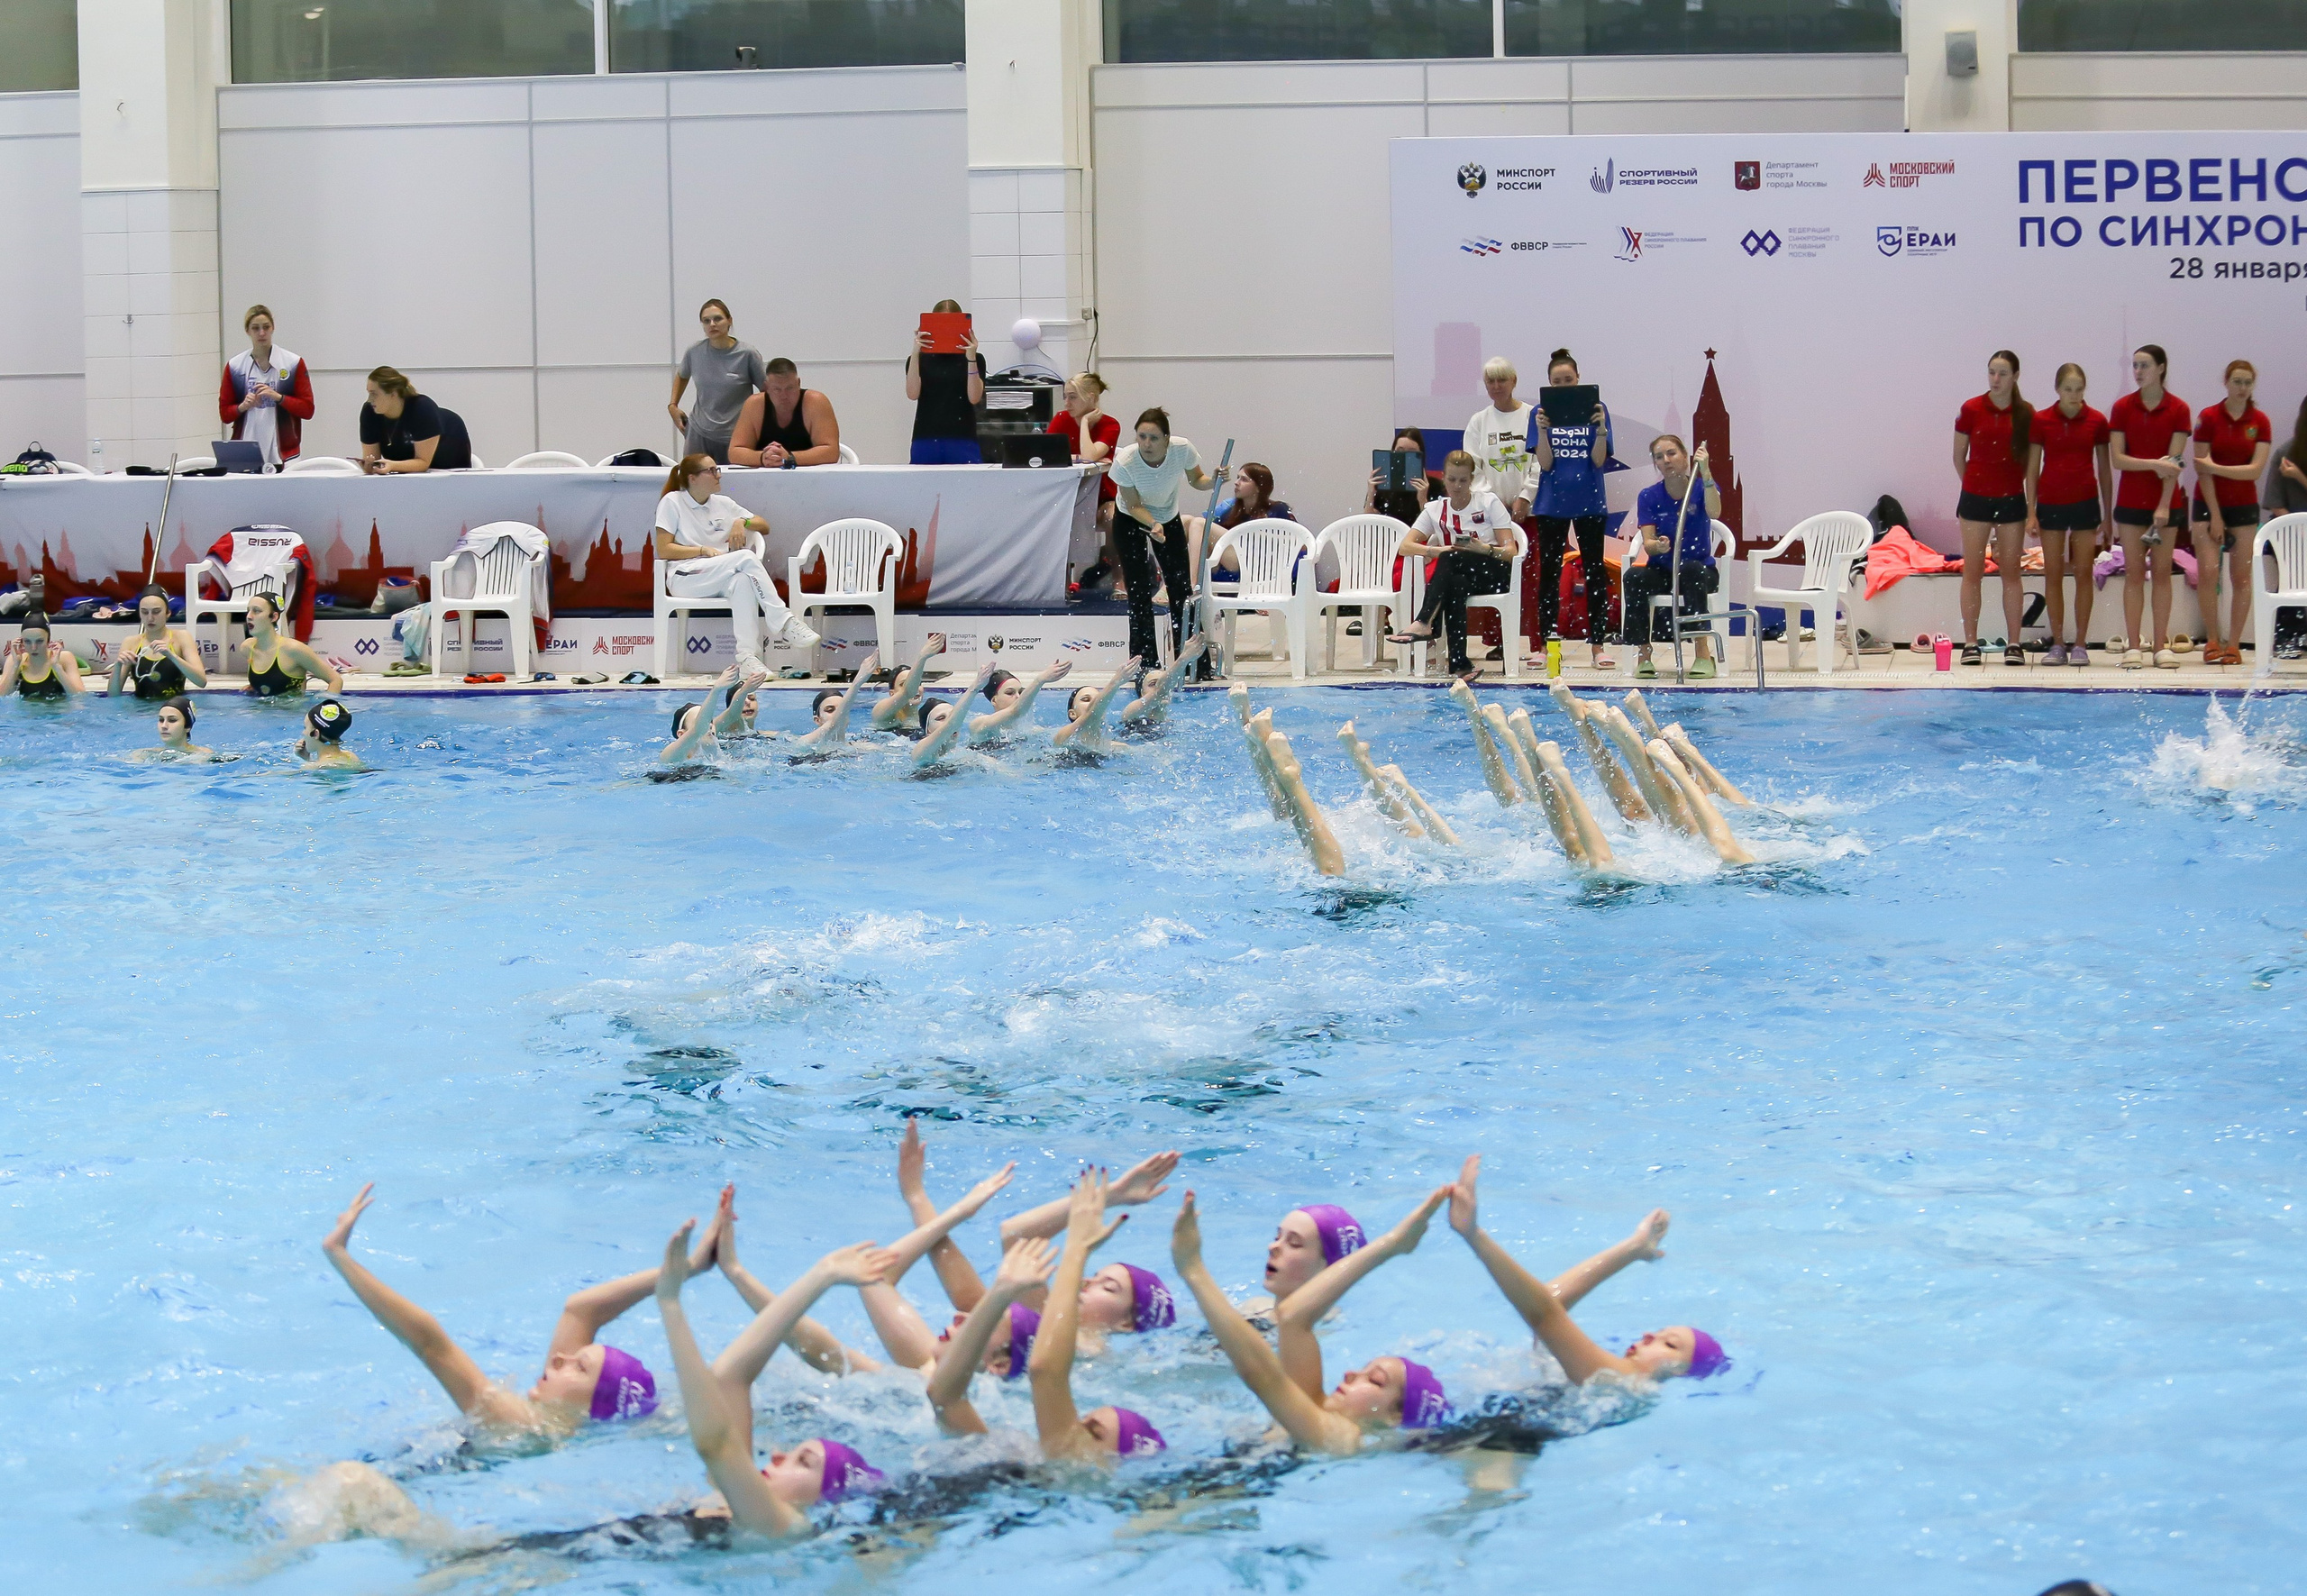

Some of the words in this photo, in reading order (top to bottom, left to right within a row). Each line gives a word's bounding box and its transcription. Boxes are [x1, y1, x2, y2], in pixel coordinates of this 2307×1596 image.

[1765, 161, 1819, 169] Департамент
[1889, 160, 1956, 175] МОСКОВСКИЙ
[1496, 169, 1555, 178] МИНСПОРТ
[1619, 168, 1698, 178] СПОРТИВНЫЙ
[1890, 176, 1919, 187] СПОРТ
[2019, 157, 2307, 203] ПЕРВЕНС
[1497, 182, 1542, 191] РОССИИ
[2020, 215, 2083, 248] ПО
[1907, 233, 1956, 247] ЕРАИ
[1510, 242, 1549, 251] ФВВСР
[2169, 257, 2204, 278] 28
[1552, 438, 1588, 446] DOHA
[1554, 449, 1588, 458] 2024
[2021, 592, 2047, 628] 2
[613, 646, 634, 655] СПОРТ
